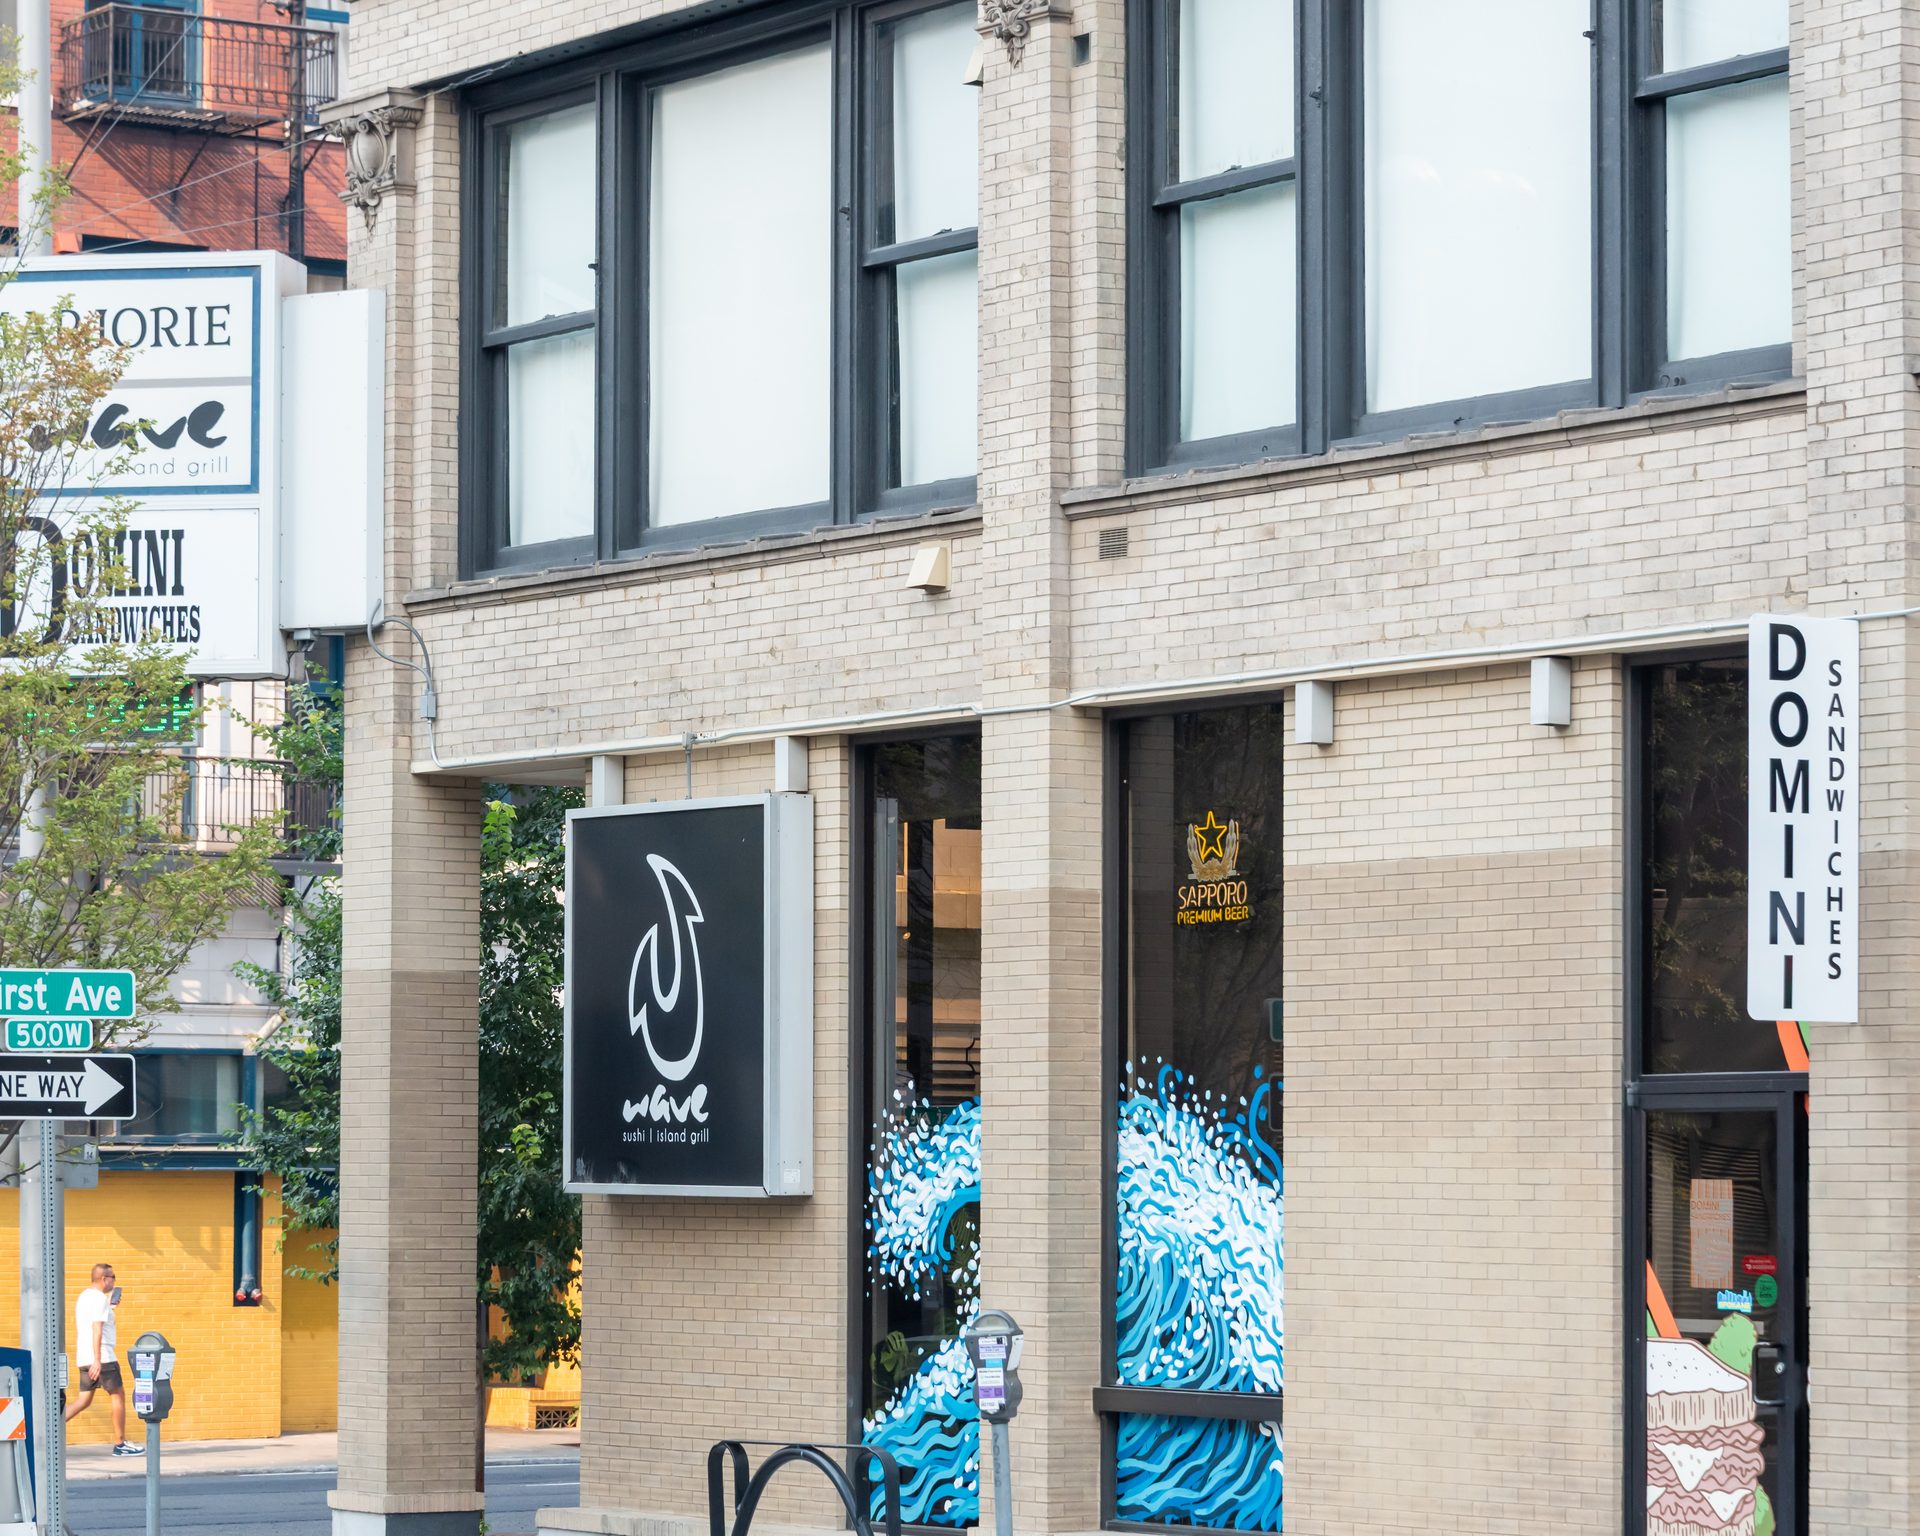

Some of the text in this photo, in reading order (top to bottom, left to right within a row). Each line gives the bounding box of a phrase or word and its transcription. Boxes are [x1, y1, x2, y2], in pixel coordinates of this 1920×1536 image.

[187, 455, 228, 477] grill
[71, 605, 201, 644] ANDWICHES
[1769, 623, 1809, 1010] DOMINI
[1826, 659, 1845, 980] SANDWICHES
[1178, 881, 1247, 909] SAPPORO
[1177, 905, 1249, 925] PREMIUM BEER
[65, 976, 122, 1012] Ave
[38, 1074, 85, 1098] WAY
[622, 1083, 709, 1123] wave
[622, 1127, 645, 1142] sushi
[656, 1127, 686, 1142] island
[690, 1127, 709, 1145] grill
